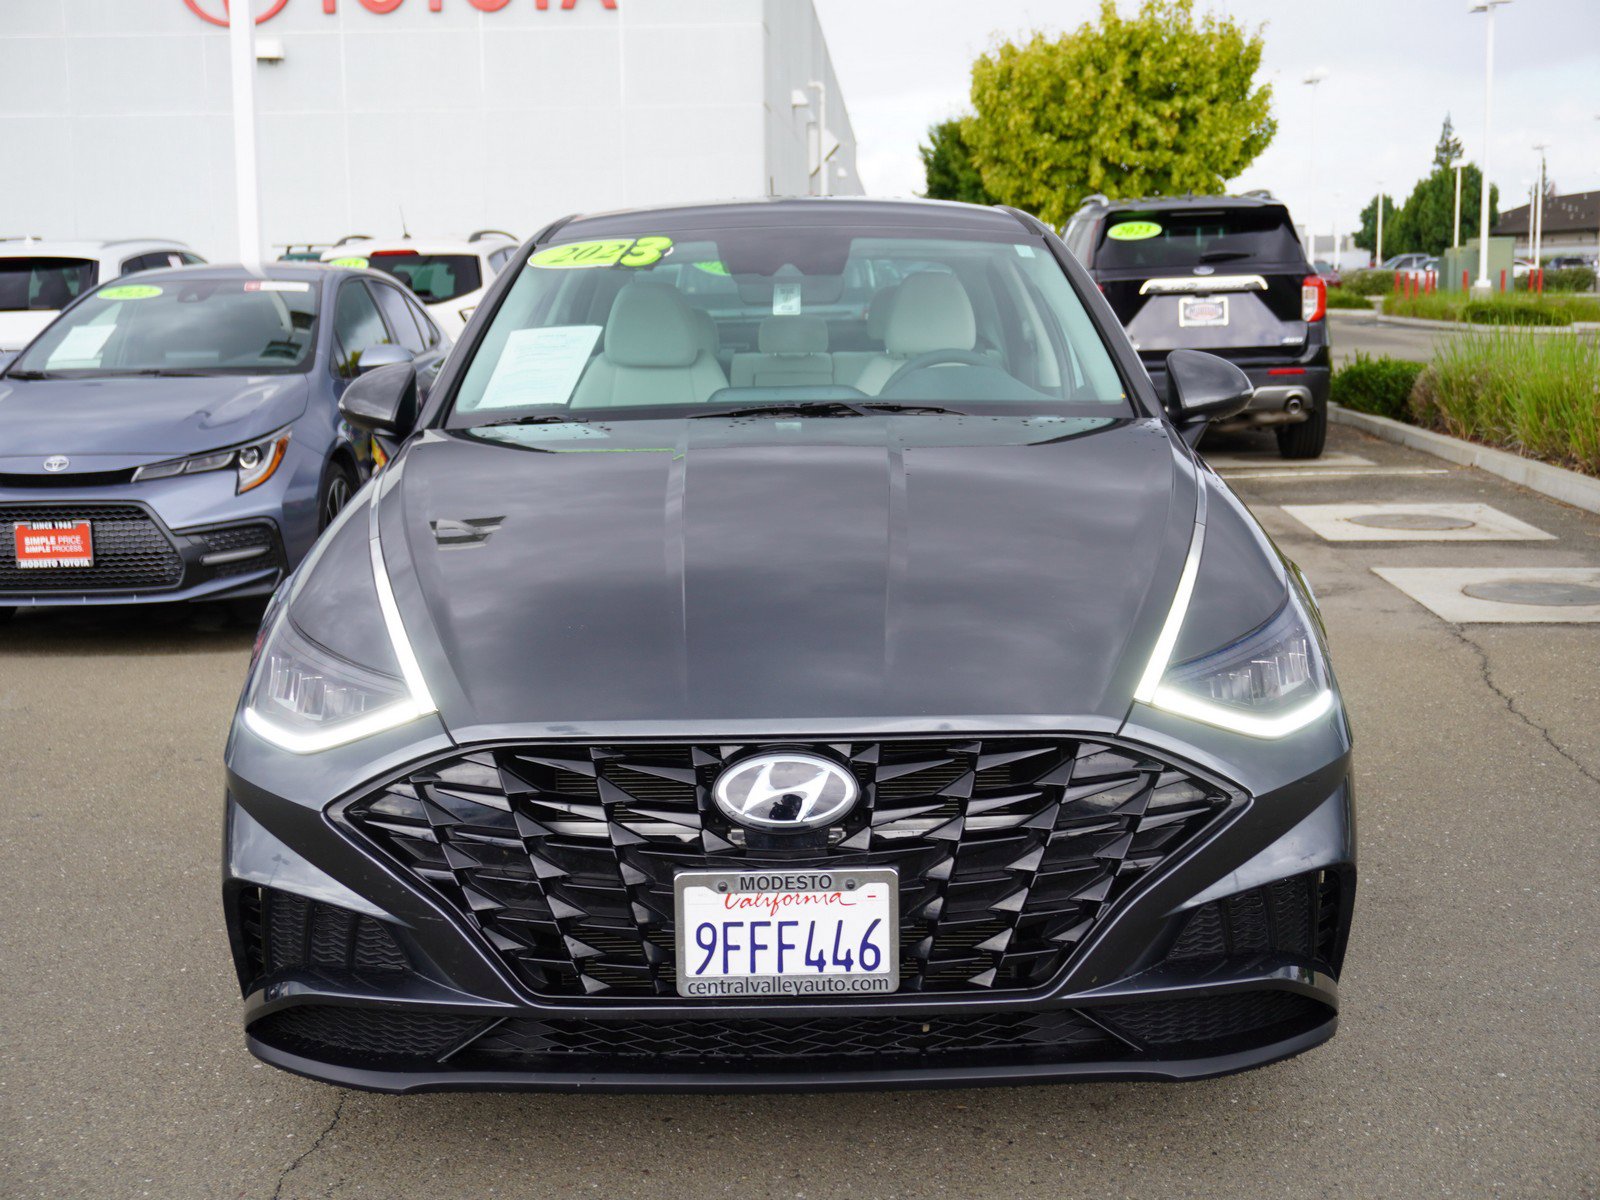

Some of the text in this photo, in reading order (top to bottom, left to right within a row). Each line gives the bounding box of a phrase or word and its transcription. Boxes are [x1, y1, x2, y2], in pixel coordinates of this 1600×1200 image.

[547, 236, 673, 268] 2023
[32, 521, 53, 530] SINCE
[25, 536, 56, 545] SIMPLE
[20, 559, 90, 568] MODESTO TOYOTA
[739, 874, 833, 891] MODESTO
[724, 892, 857, 917] California
[694, 917, 882, 976] 9FFF446
[687, 976, 890, 996] centralvalleyauto.com
